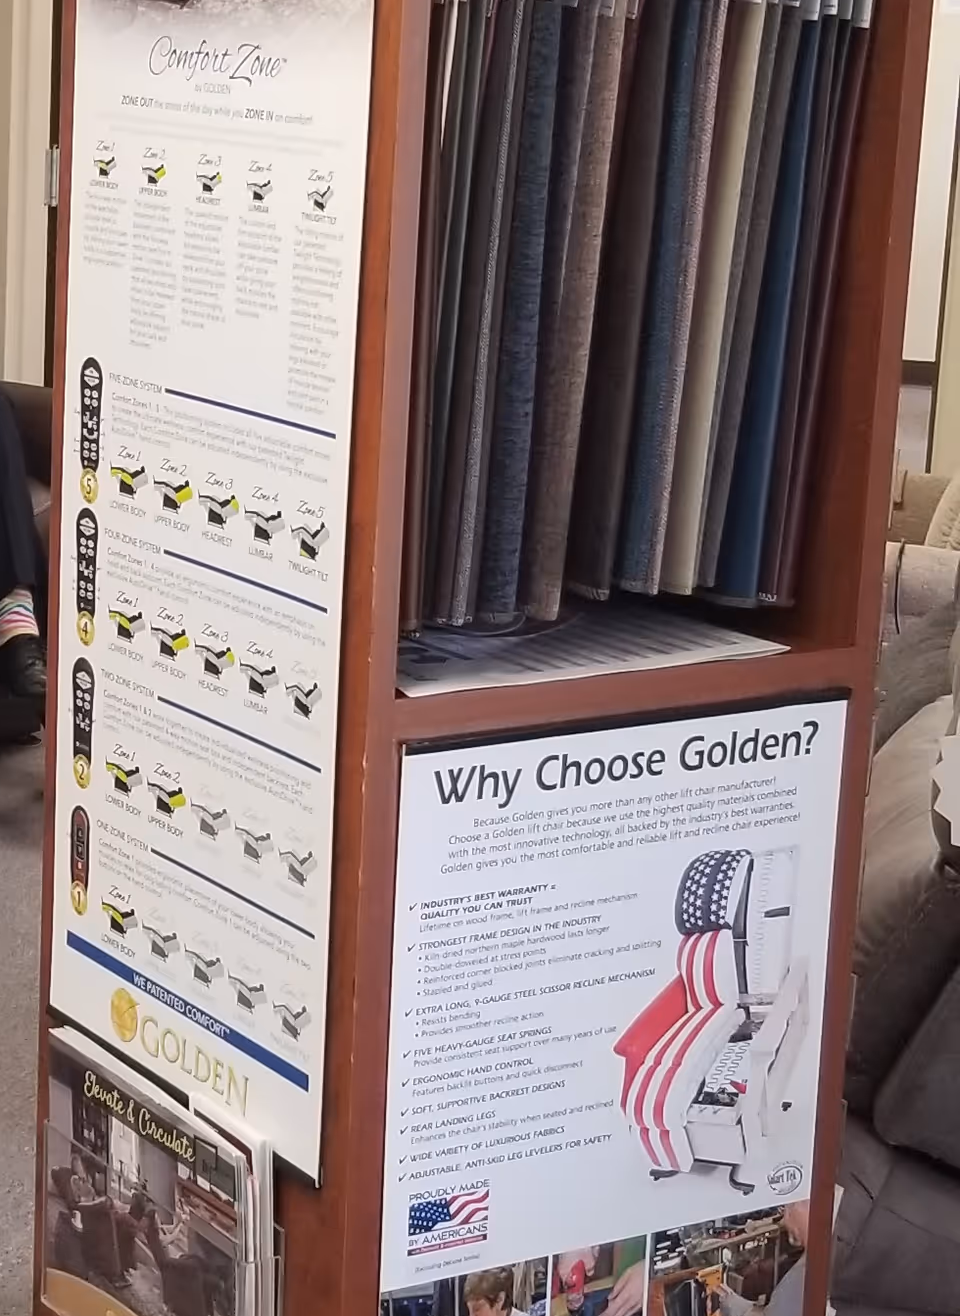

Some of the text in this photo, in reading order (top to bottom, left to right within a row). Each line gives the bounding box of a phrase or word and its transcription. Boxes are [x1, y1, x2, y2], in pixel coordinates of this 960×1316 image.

[148, 36, 233, 81] Comfort
[121, 95, 274, 122] ZONE OUT ZONE IN
[85, 478, 92, 495] 5
[82, 620, 88, 638] 4
[77, 762, 86, 780] 2
[434, 720, 819, 809] Why Choose Golden?
[105, 793, 141, 817] LOWER BODY
[448, 833, 482, 845] Choose
[483, 832, 490, 840] a
[492, 827, 525, 839] Golden
[566, 816, 601, 828] because
[603, 814, 617, 822] we
[619, 812, 634, 821] use
[636, 809, 650, 818] the
[652, 804, 684, 817] highest
[686, 800, 715, 812] quality
[756, 786, 797, 801] combined
[473, 816, 510, 828] Because
[511, 810, 544, 822] Golden
[546, 807, 569, 819] gives
[571, 805, 587, 816] you
[589, 801, 613, 811] more
[615, 798, 635, 808] than
[637, 796, 652, 805] any
[654, 791, 678, 802] other
[147, 814, 184, 838] UPPER BODY
[448, 847, 469, 859] with
[471, 846, 486, 855] the
[489, 842, 511, 852] most
[513, 836, 559, 849] innovative
[614, 824, 625, 835] all
[627, 819, 658, 833] backed
[659, 819, 670, 830] by
[672, 817, 686, 826] the
[730, 807, 748, 818] best
[440, 862, 473, 874] Golden
[475, 859, 498, 871] gives
[500, 856, 517, 867] you
[519, 852, 535, 862] the
[537, 848, 559, 859] most
[561, 840, 615, 856] comfortable
[616, 836, 633, 848] and
[683, 826, 700, 838] and
[702, 824, 730, 835] recline
[474, 891, 496, 901] BEST
[497, 883, 548, 898] WARRANTY
[420, 896, 533, 920] QUALITY YOU CAN TRUST
[133, 972, 147, 990] WE
[147, 978, 185, 1013] PATENTED
[141, 1015, 249, 1118] GOLDEN
[84, 1070, 196, 1162] Elevate & Circulate
[408, 1178, 490, 1202] PROUDLY MADE
[421, 1222, 488, 1245] AMERICANS
